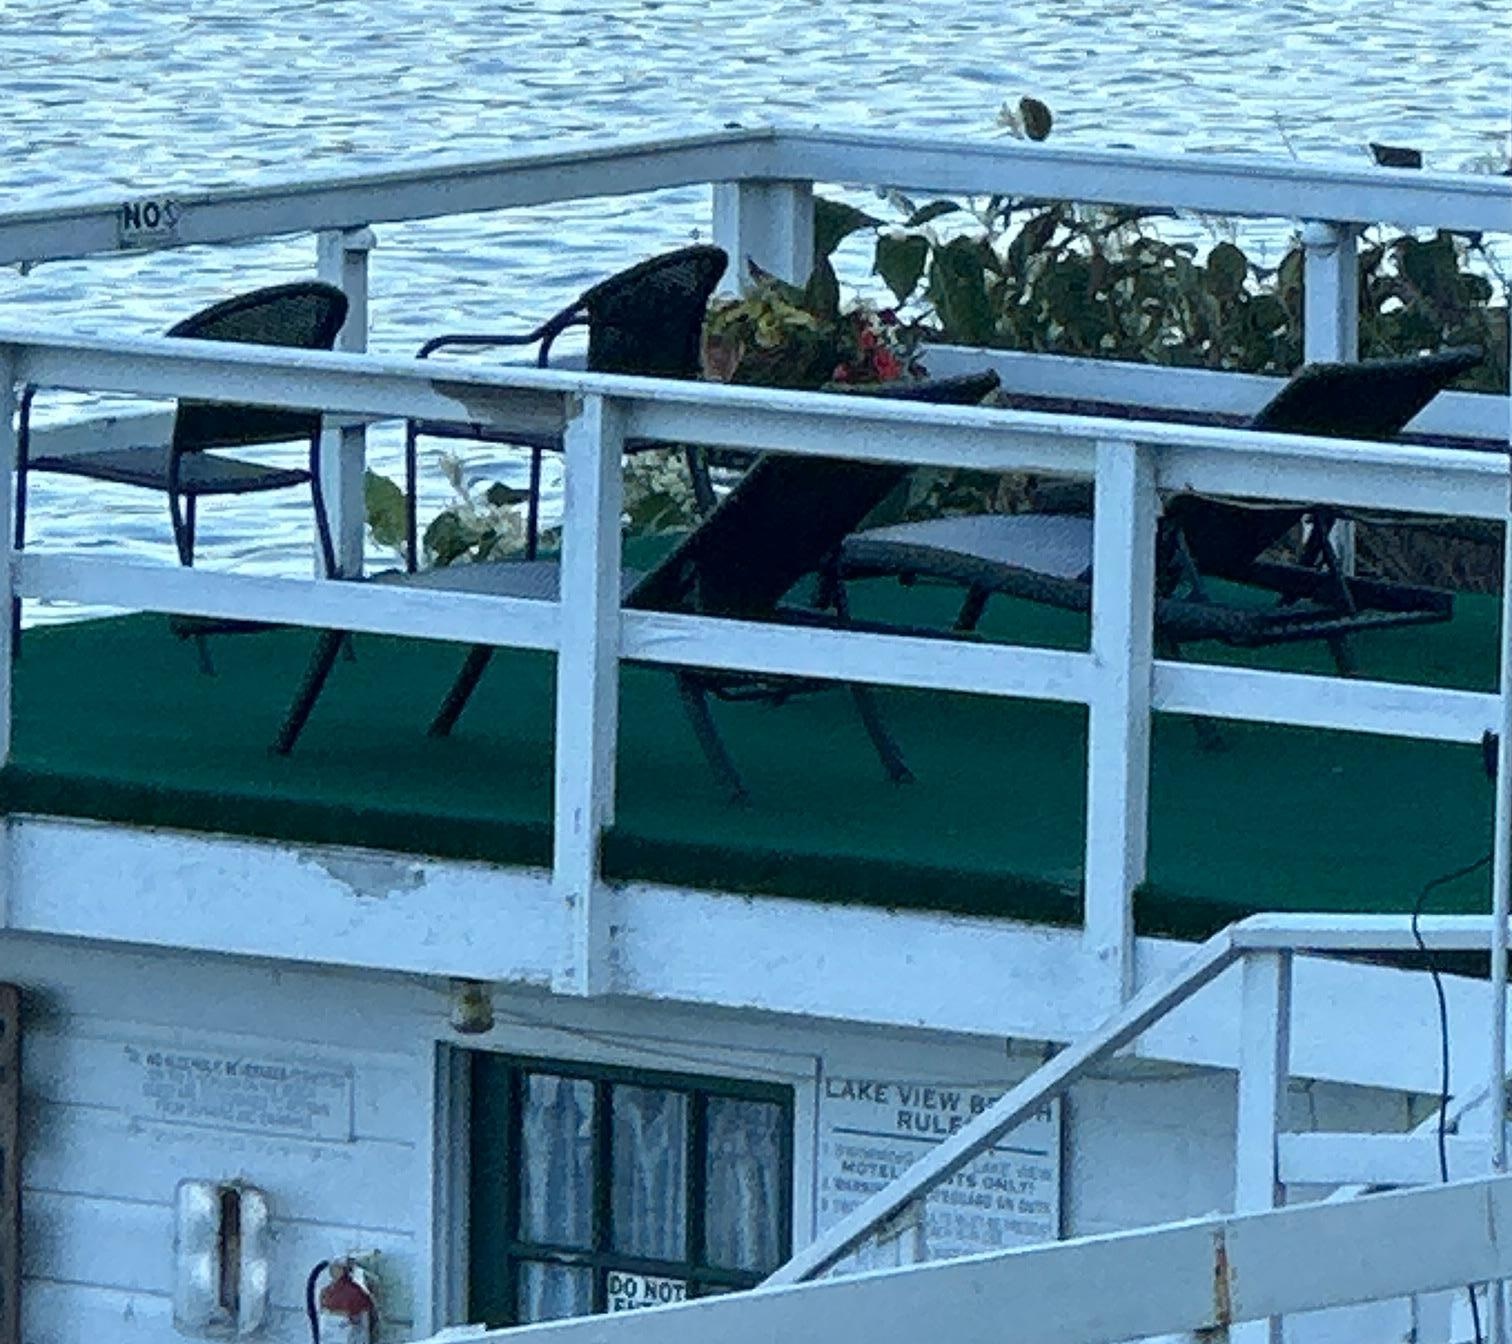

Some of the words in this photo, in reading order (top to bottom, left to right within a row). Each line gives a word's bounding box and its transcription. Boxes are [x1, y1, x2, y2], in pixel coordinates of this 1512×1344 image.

[825, 1076, 889, 1104] LAKE
[897, 1084, 960, 1112] VIEW
[609, 1275, 638, 1298] DO
[643, 1280, 685, 1303] NOT
